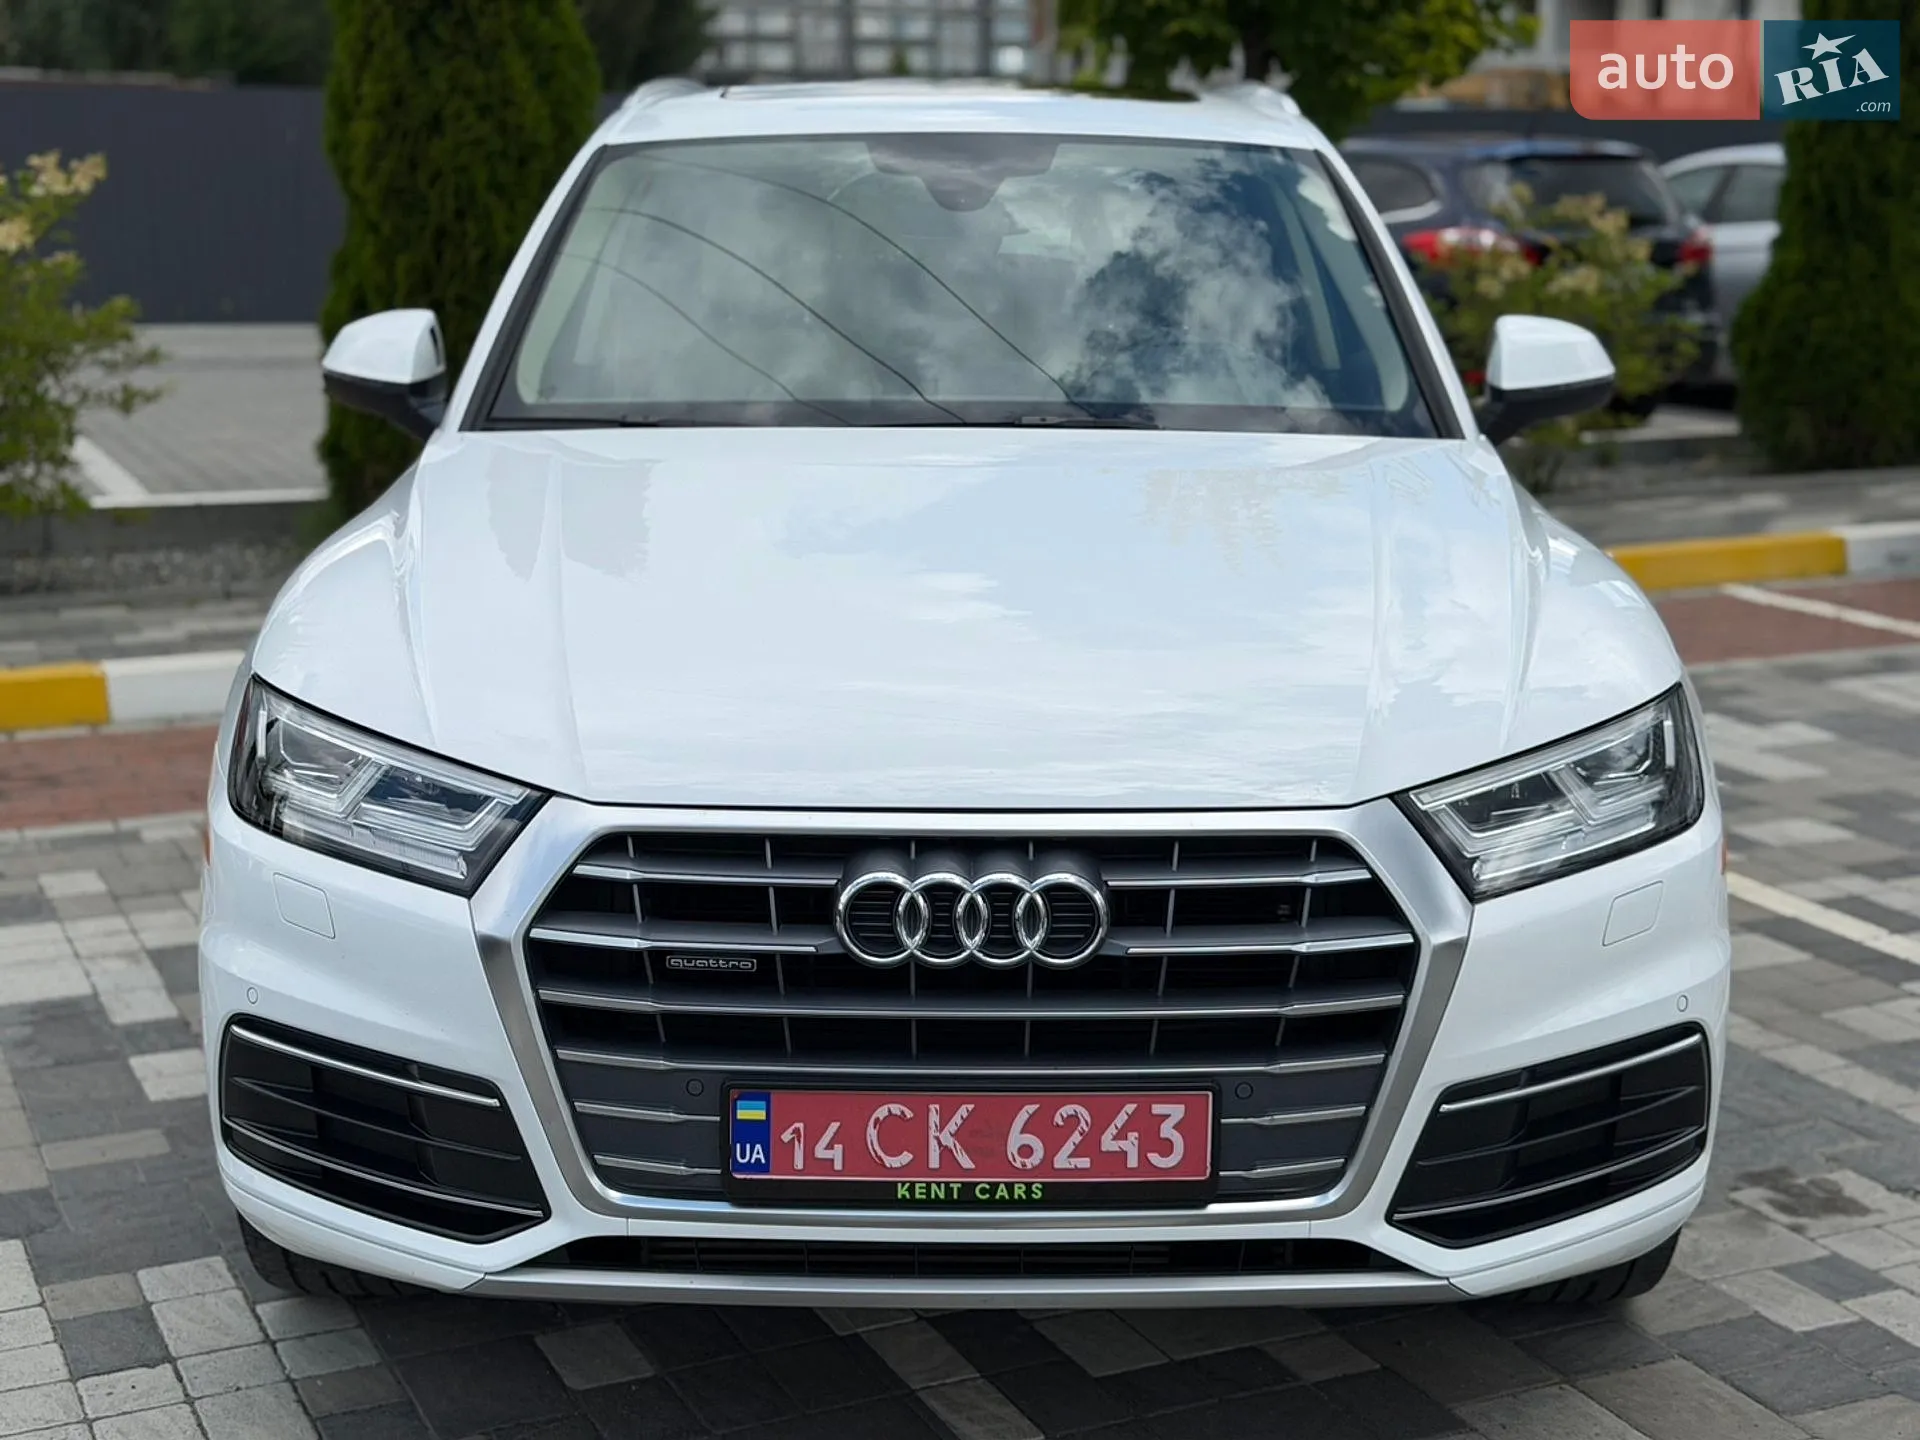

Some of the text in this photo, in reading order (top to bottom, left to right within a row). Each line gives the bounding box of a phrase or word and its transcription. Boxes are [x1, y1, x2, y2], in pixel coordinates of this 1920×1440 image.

[670, 958, 752, 968] quattro
[780, 1103, 1186, 1171] 14 CK 6243
[735, 1143, 766, 1165] UA
[897, 1182, 1044, 1200] KENT CARS
